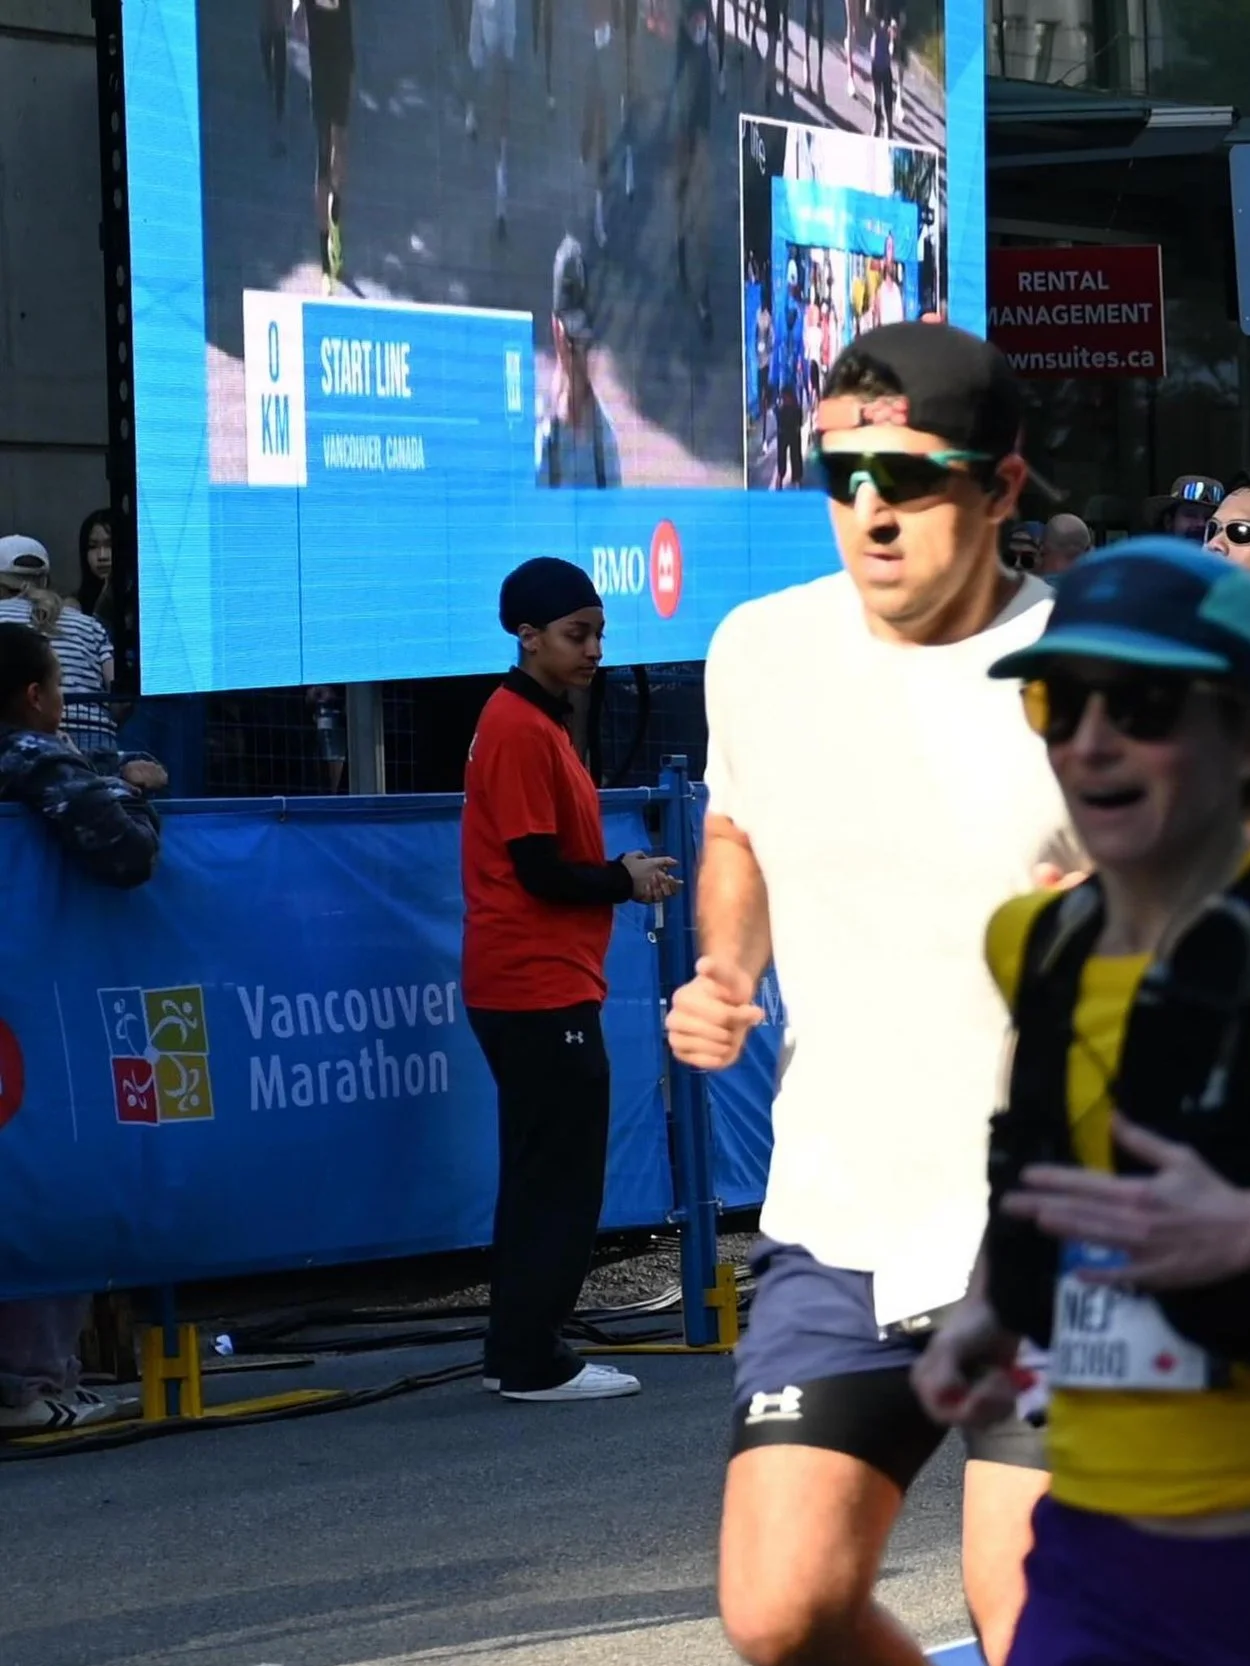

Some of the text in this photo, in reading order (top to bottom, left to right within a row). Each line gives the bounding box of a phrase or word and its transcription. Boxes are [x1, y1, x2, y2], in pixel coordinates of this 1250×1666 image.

[1018, 271, 1110, 292] RENTAL
[320, 337, 412, 398] START LINE
[1007, 345, 1155, 370] wnsuites.ca
[260, 394, 290, 457] KM
[385, 435, 426, 471] CANADA
[592, 545, 645, 596] BMO
[236, 981, 457, 1040] Vancouver
[250, 1039, 449, 1112] Marathon
